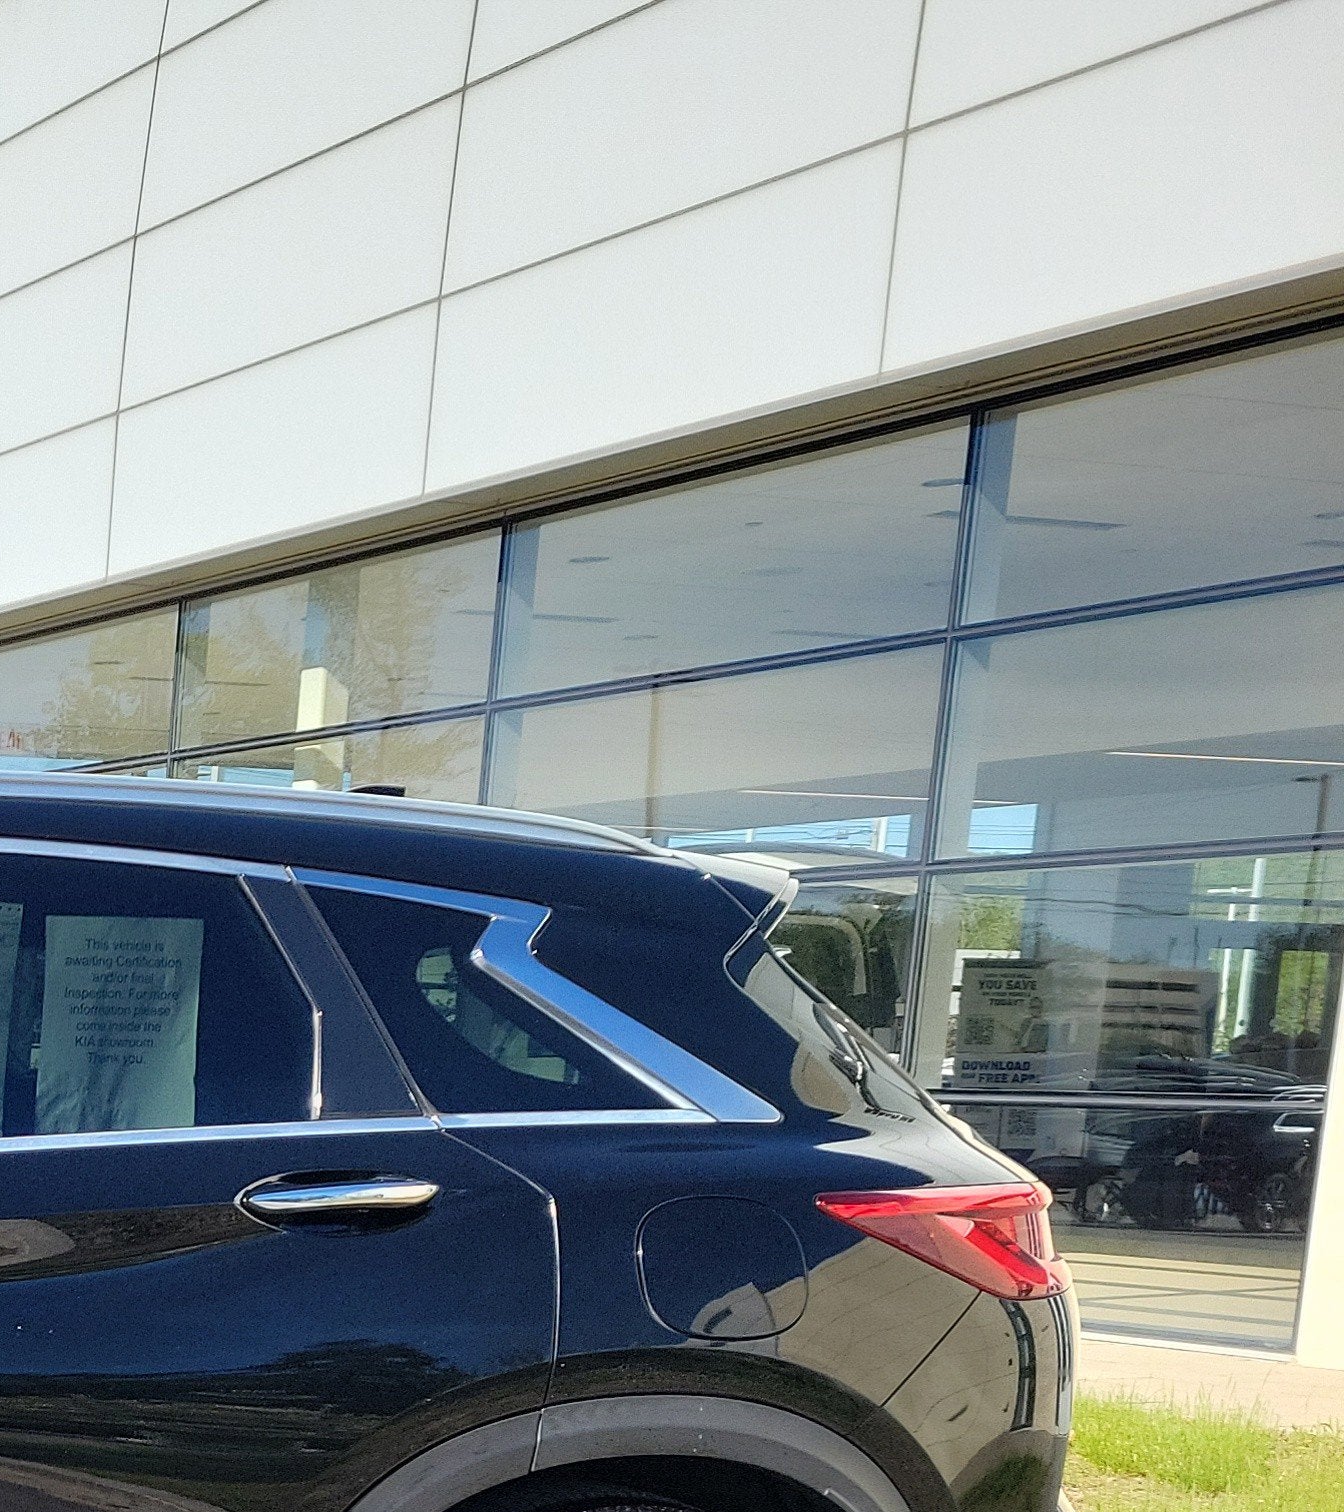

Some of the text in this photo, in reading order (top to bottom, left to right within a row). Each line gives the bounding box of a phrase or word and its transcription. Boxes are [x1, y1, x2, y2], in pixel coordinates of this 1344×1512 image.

[85, 937, 164, 951] This vehicle is
[64, 956, 182, 968] awaiting Certification
[92, 972, 127, 983] and/or
[978, 980, 1038, 990] YOU SAVE
[148, 989, 180, 1000] more
[70, 1003, 171, 1018] information please
[76, 1020, 162, 1033] come inside the
[74, 1035, 96, 1047] KIA
[87, 1052, 118, 1064] Thank
[962, 1060, 1031, 1071] DOWNLOAD
[978, 1072, 1008, 1083] FREE
